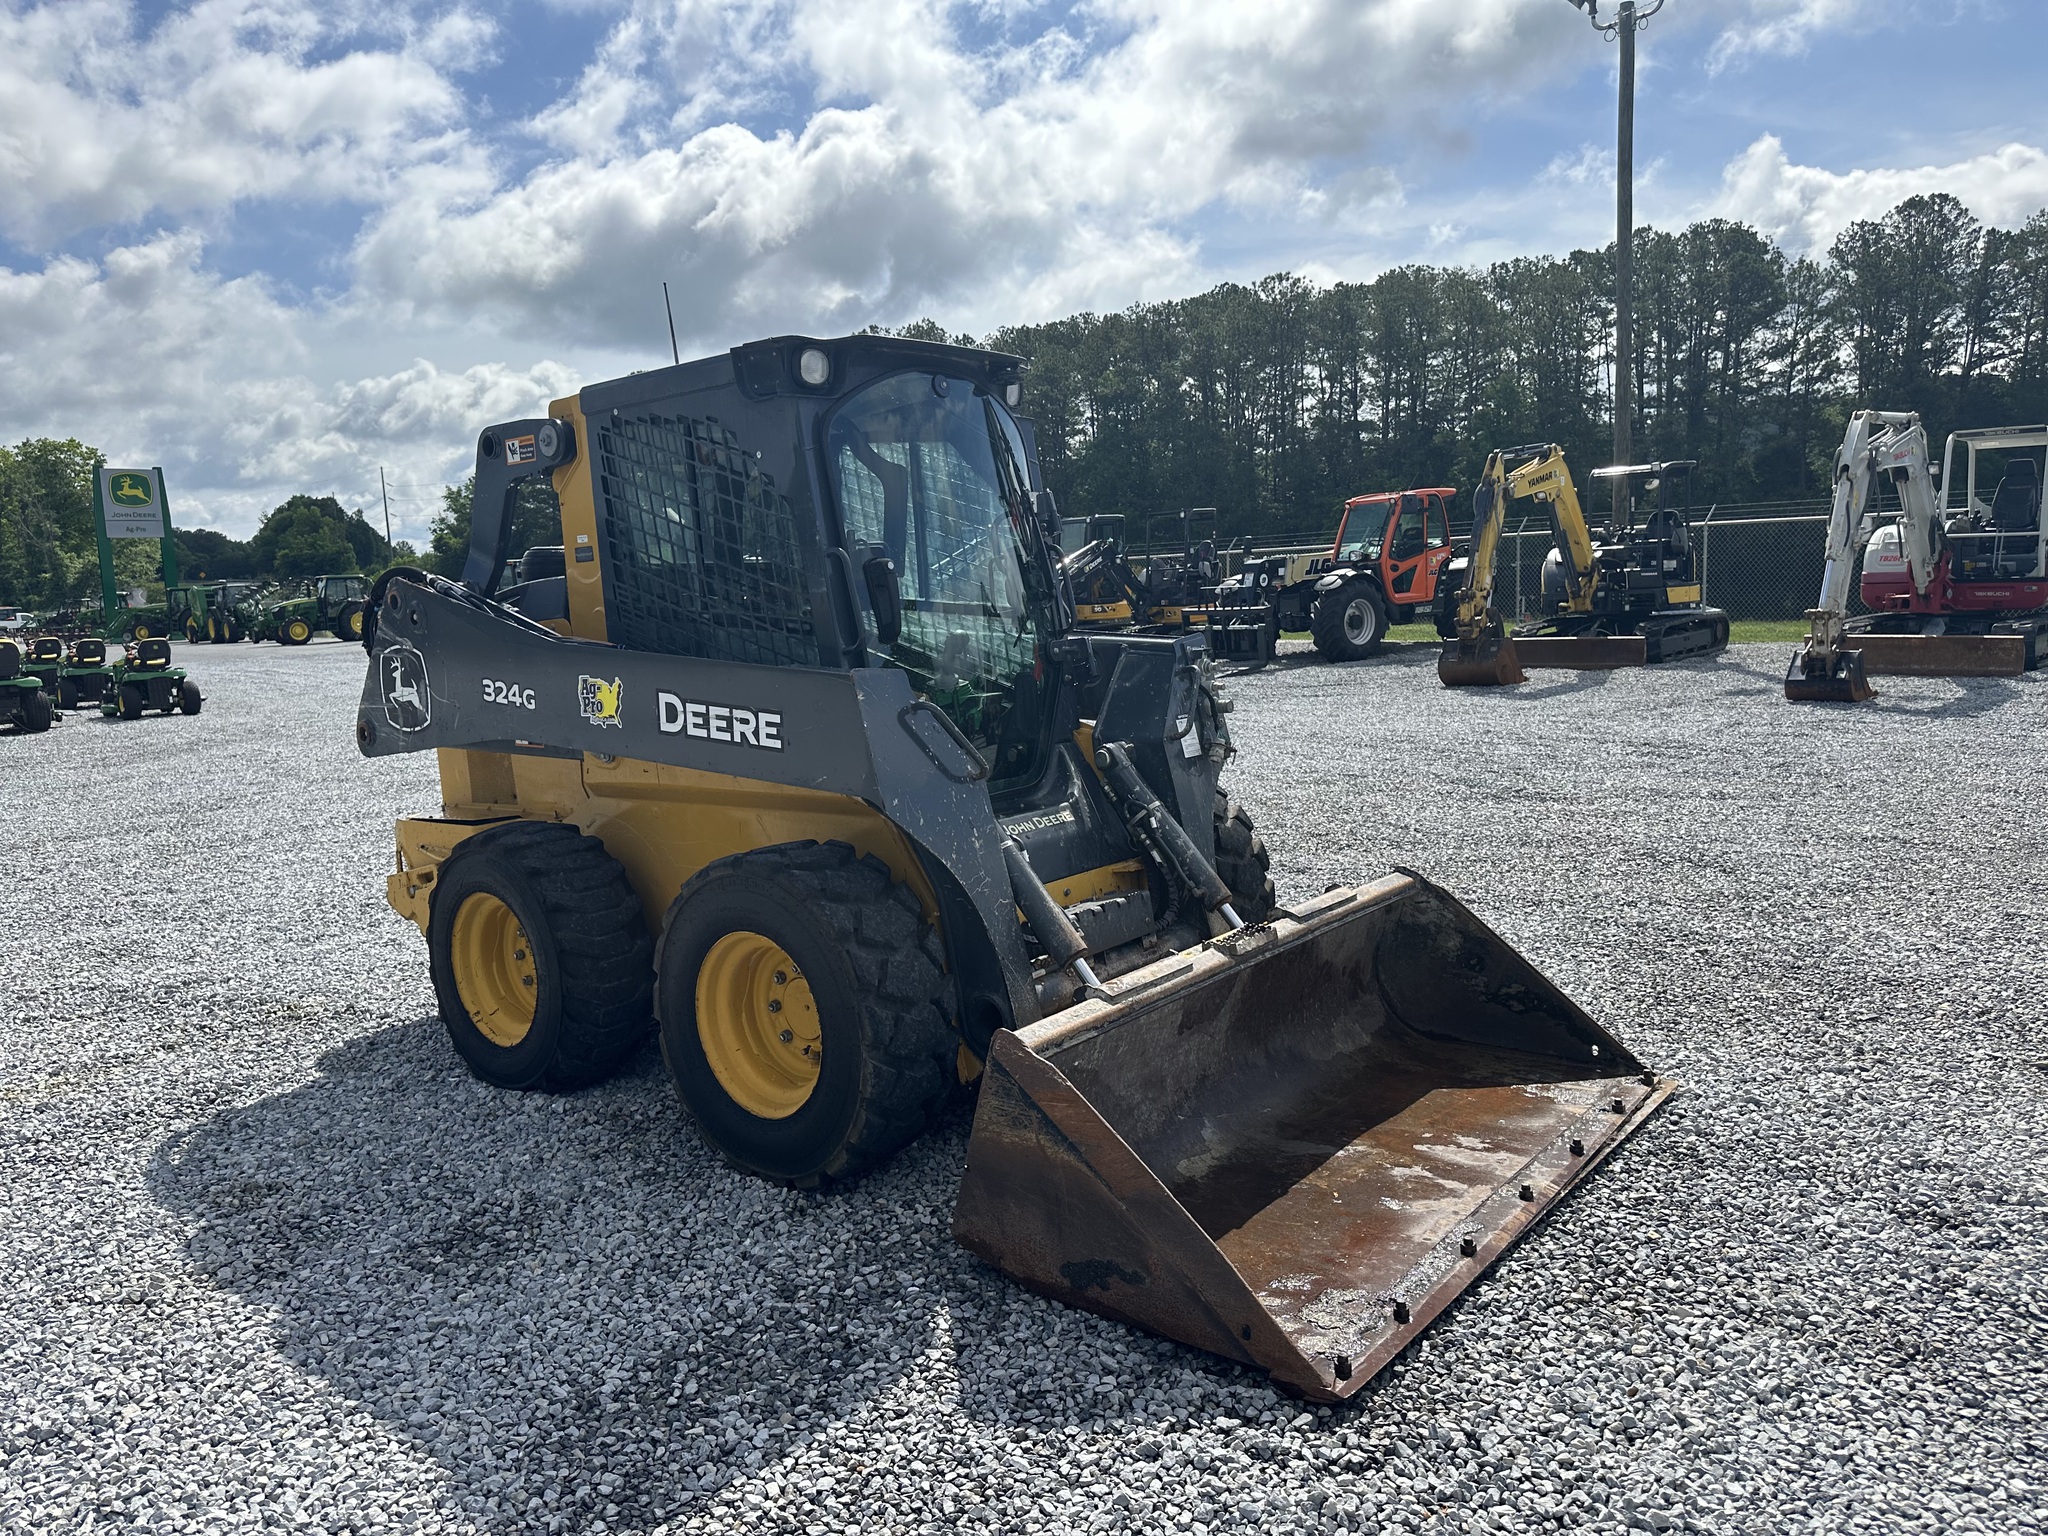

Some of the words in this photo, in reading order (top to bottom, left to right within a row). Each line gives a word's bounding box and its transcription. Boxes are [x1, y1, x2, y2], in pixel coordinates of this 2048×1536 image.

[1528, 471, 1553, 488] YANMAR
[132, 511, 157, 519] DEERE
[1304, 557, 1333, 576] JLG
[482, 678, 536, 710] 324G
[581, 678, 601, 700] Ag-
[582, 696, 603, 714] Pro
[658, 692, 782, 749] DEERE
[1002, 820, 1036, 835] JOHN
[1032, 811, 1076, 829] DEERE
